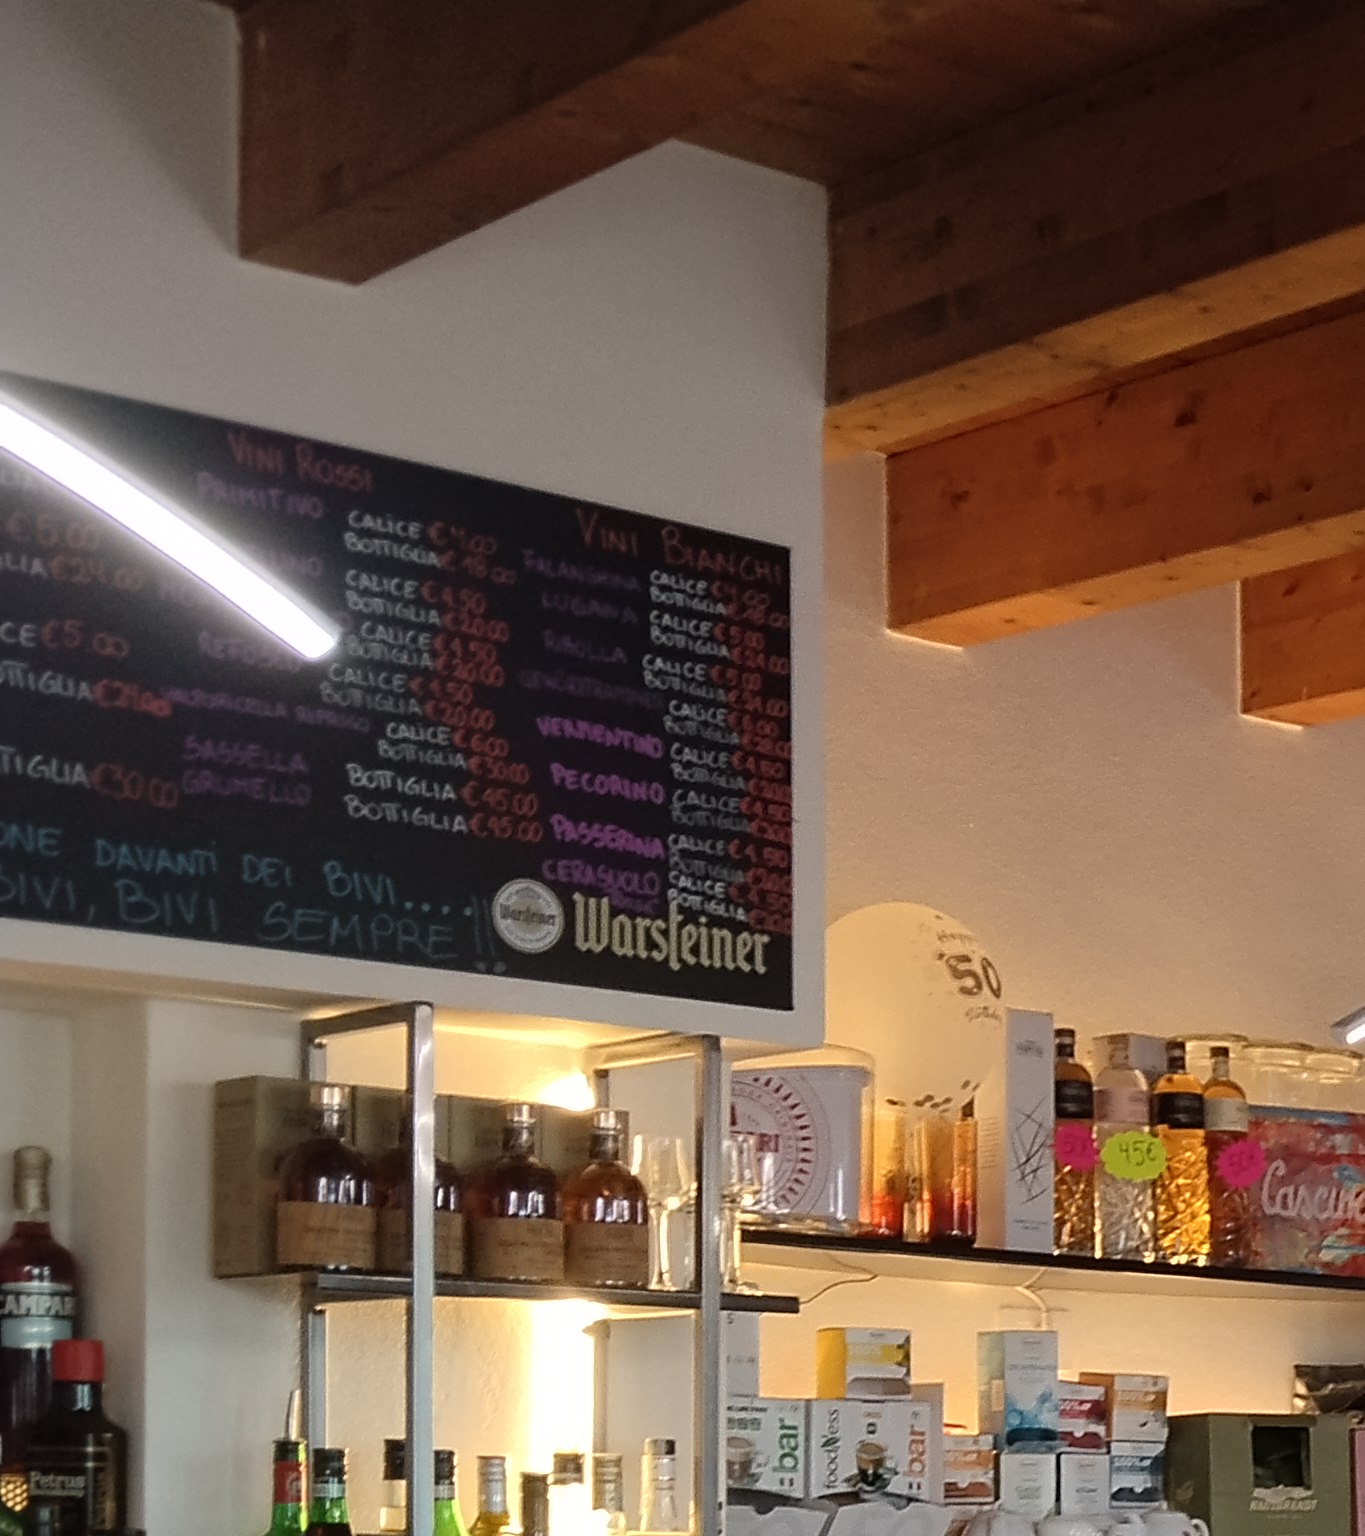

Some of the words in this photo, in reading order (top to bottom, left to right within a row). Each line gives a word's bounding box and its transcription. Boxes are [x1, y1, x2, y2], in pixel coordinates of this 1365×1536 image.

[348, 510, 423, 540] CALICE
[576, 507, 639, 557] VINI
[661, 524, 782, 586] BIANCHI
[345, 568, 419, 600] CALICE
[650, 569, 708, 596] CALICE
[360, 620, 433, 651] CALICE
[650, 609, 713, 638] CALICE
[328, 662, 408, 693] CALICE
[642, 653, 707, 682] CALICE
[386, 722, 451, 747] CALICE
[346, 762, 457, 802] BOTTIGLIA
[550, 761, 665, 806] PECORINO
[344, 793, 469, 835] BOTTIGLIA
[113, 877, 220, 935] BIVI
[256, 899, 457, 960] SEMPRE
[571, 890, 771, 976] Warsteiner
[1117, 1140, 1158, 1167] 45€
[29, 1470, 86, 1489] Petrus
